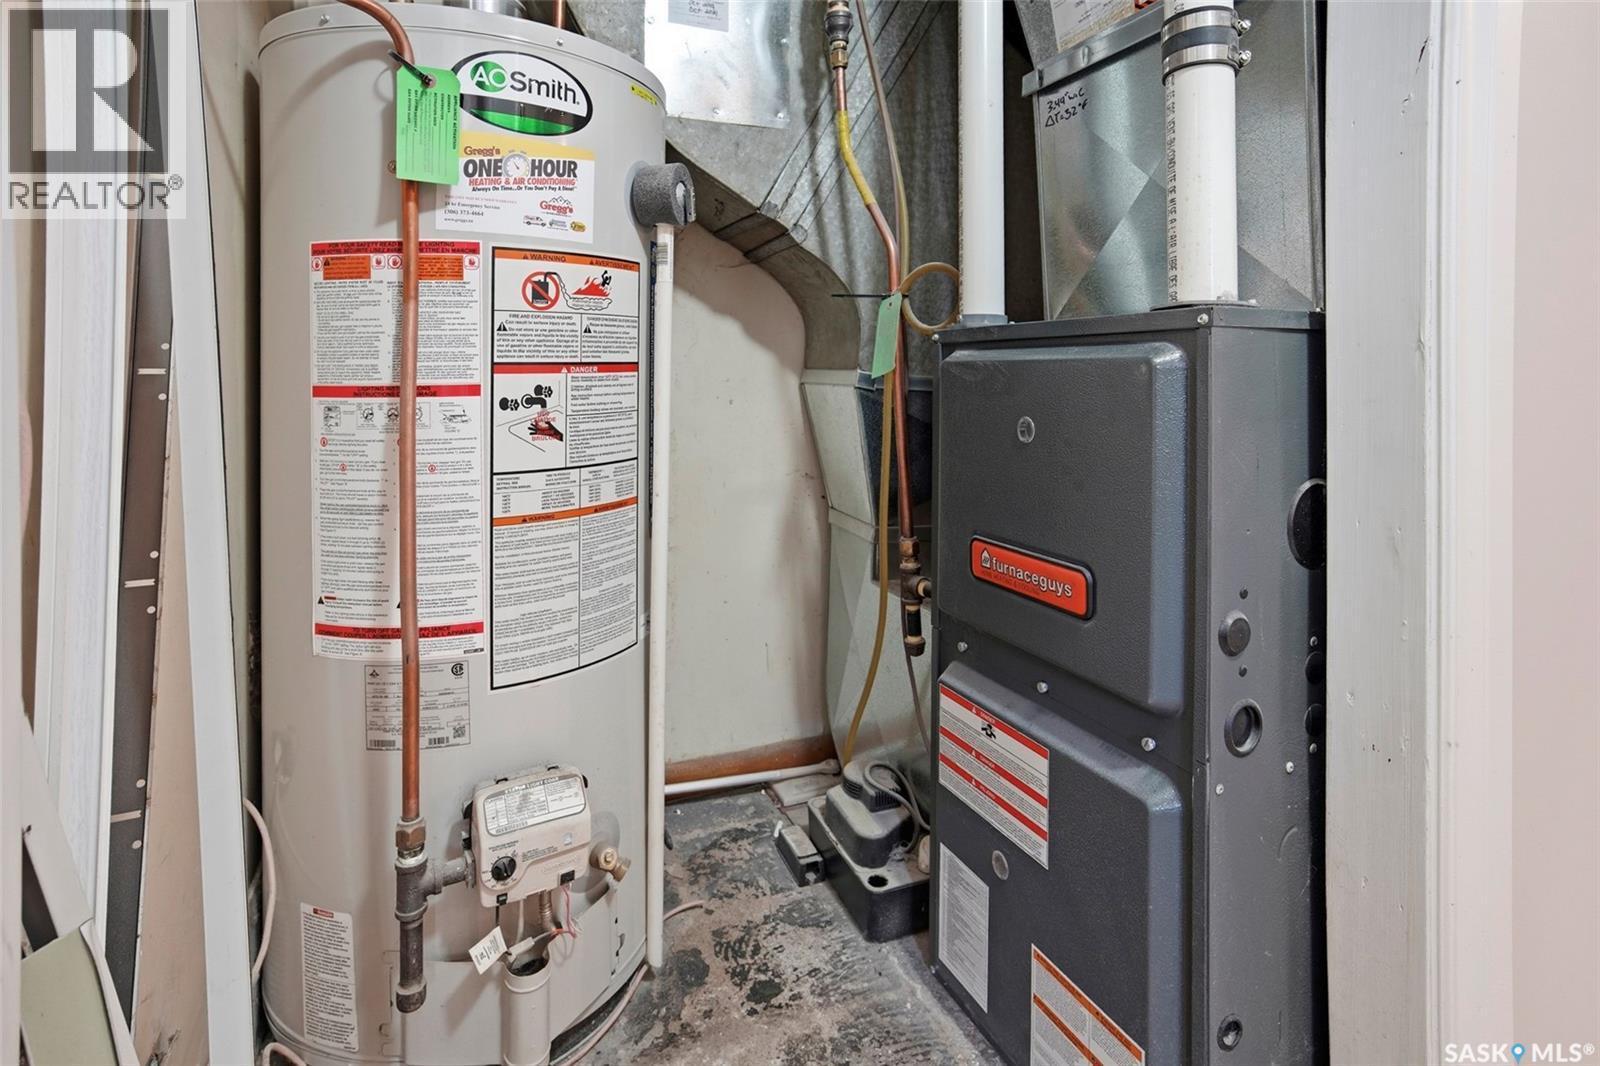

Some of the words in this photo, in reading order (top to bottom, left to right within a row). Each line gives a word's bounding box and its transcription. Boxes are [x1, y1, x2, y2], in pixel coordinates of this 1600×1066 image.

[464, 146, 500, 157] Gregg's
[464, 159, 502, 178] ONE
[530, 160, 578, 178] HOUR
[469, 178, 502, 186] HEATING
[527, 178, 576, 186] CONDITIONING
[540, 200, 574, 215] Gregg's
[530, 254, 566, 263] WARNING
[992, 557, 1072, 597] furnaceguys
